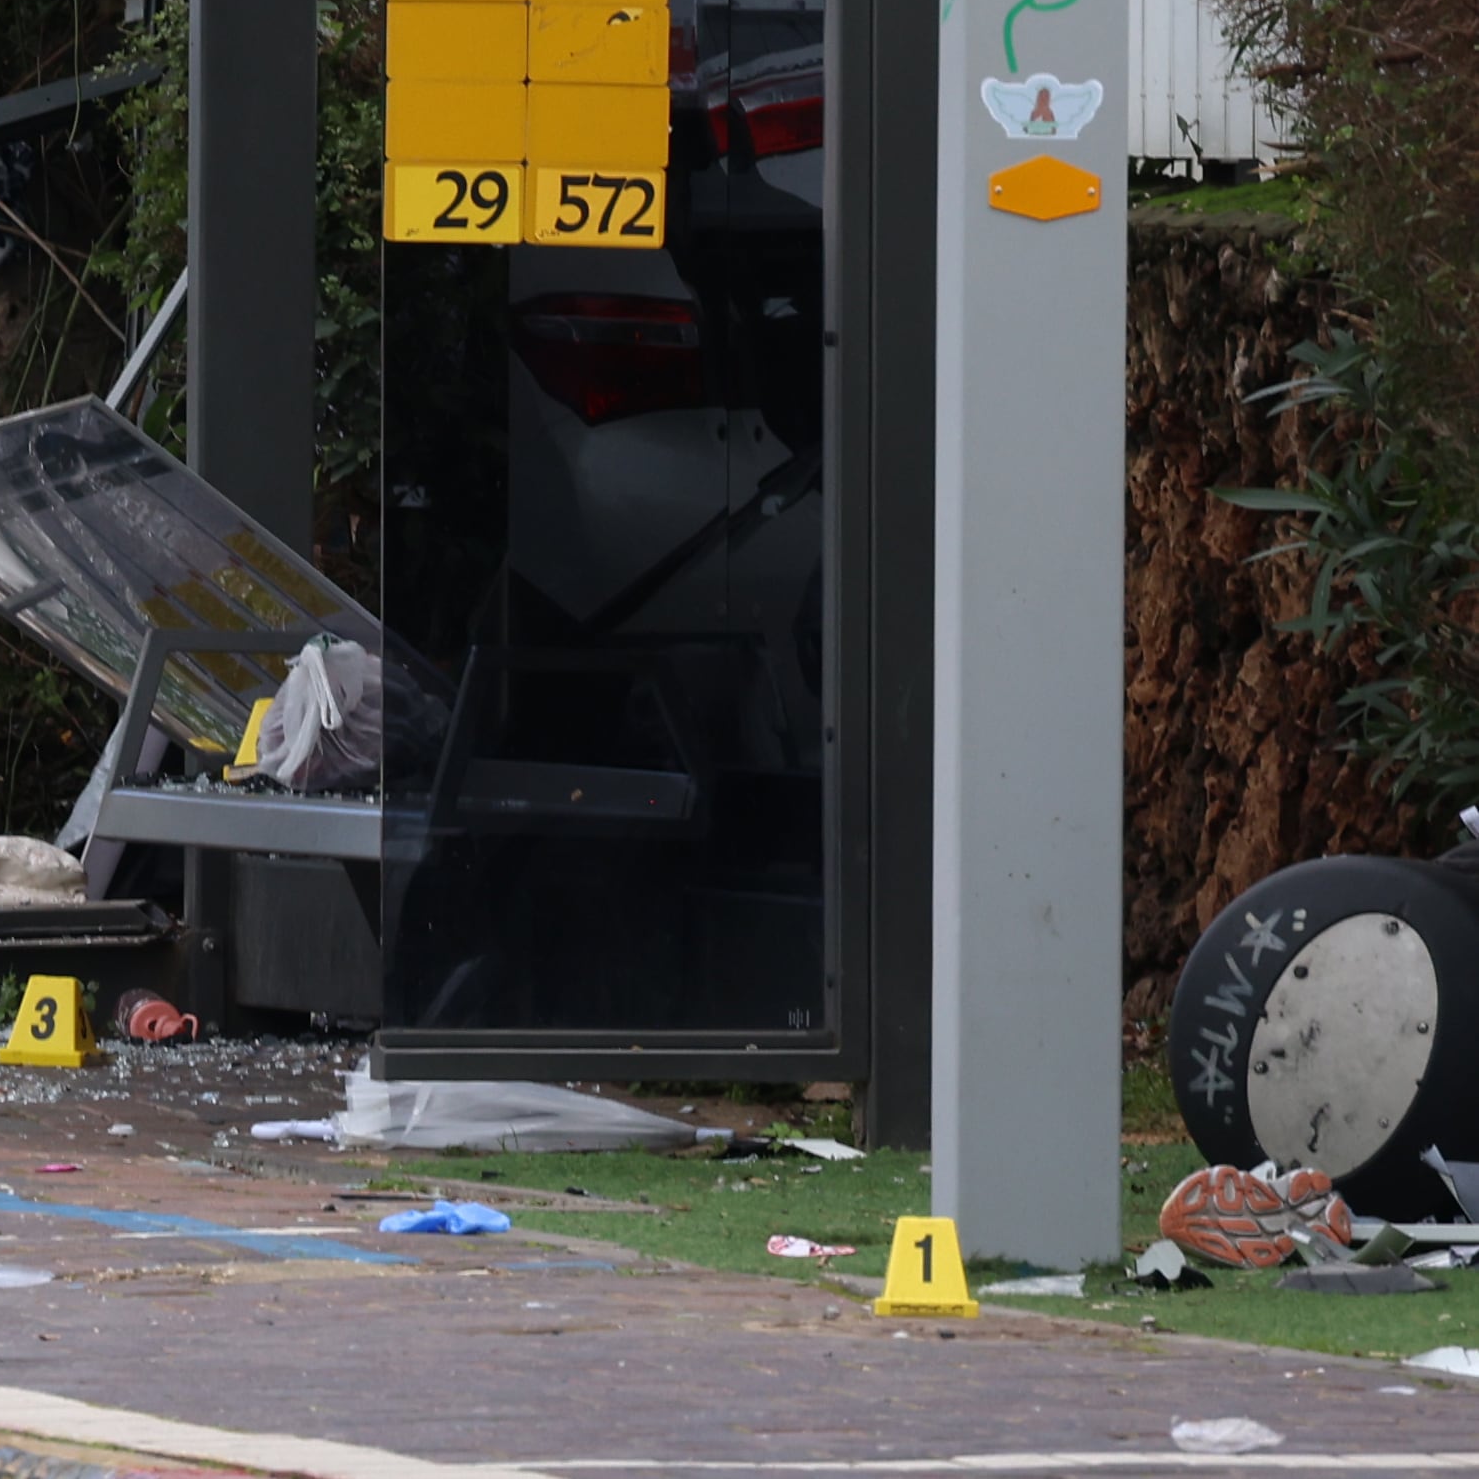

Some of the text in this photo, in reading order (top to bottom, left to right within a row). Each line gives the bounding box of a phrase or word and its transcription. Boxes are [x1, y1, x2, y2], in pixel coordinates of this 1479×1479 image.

[433, 170, 509, 231] 29
[554, 173, 655, 237] 572
[30, 996, 58, 1040] 3
[914, 1233, 933, 1284] 1
